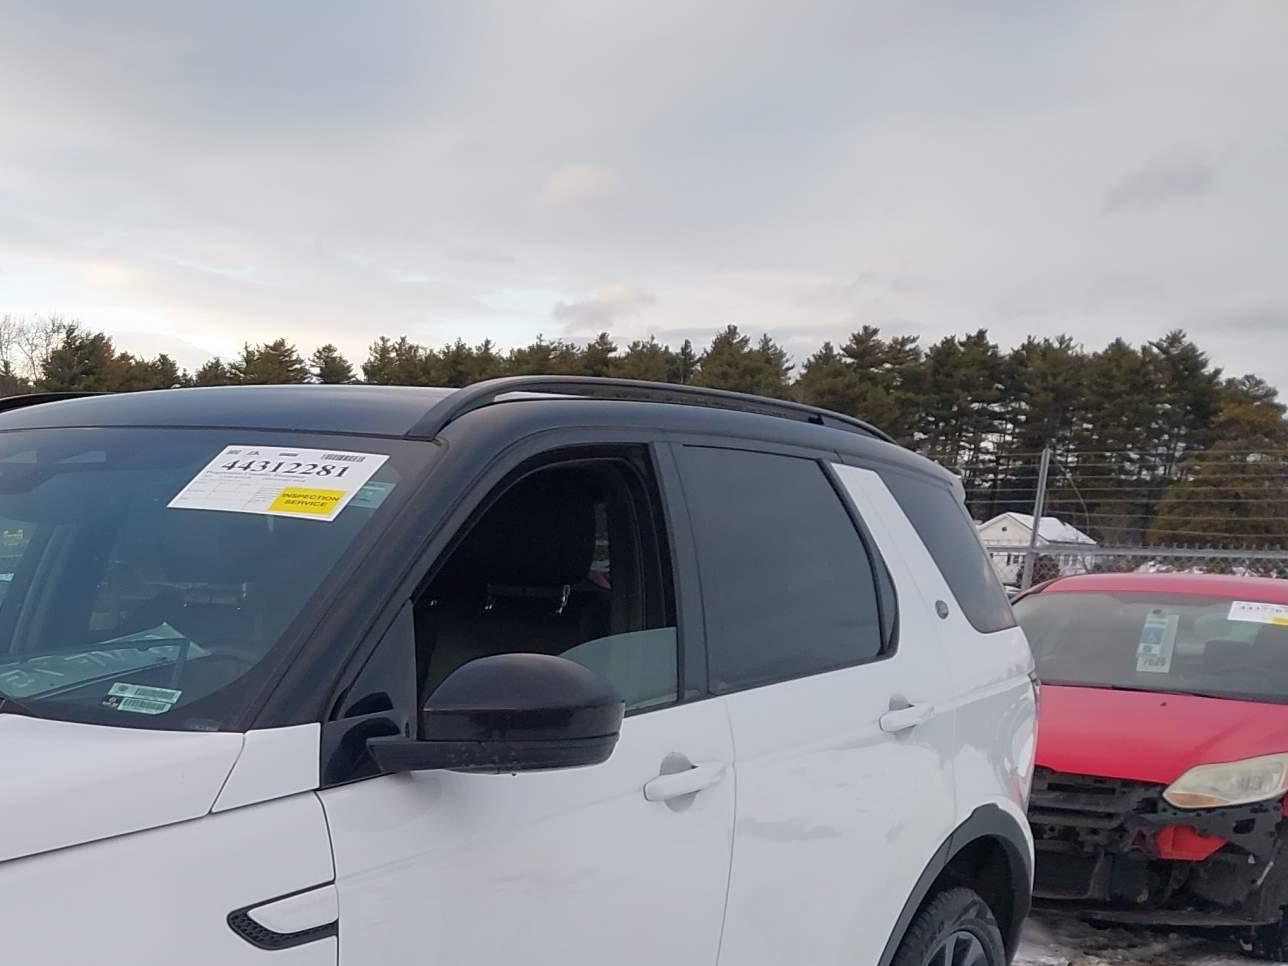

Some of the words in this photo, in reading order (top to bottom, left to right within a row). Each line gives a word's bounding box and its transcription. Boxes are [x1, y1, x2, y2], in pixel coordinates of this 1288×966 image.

[221, 459, 350, 478] 44312281
[281, 493, 341, 502] INSPECTION
[284, 499, 328, 507] SERVICE
